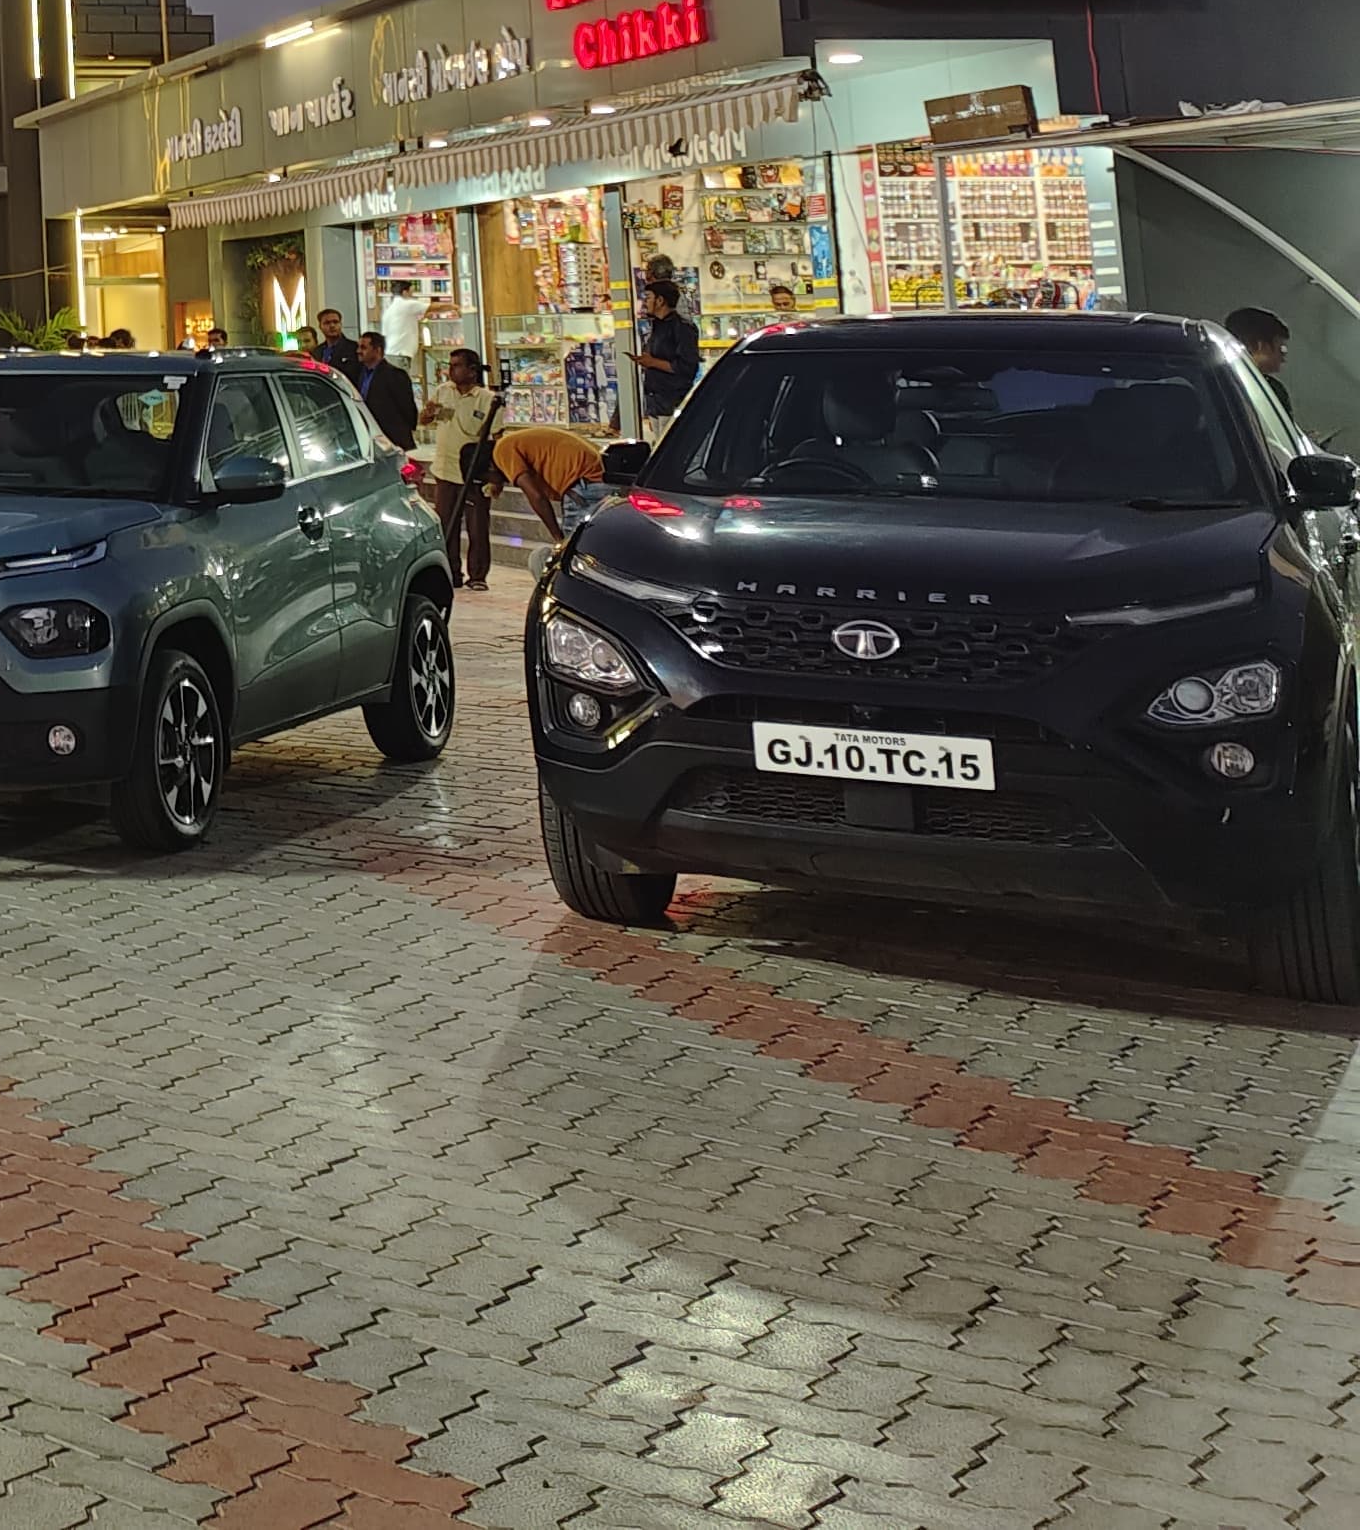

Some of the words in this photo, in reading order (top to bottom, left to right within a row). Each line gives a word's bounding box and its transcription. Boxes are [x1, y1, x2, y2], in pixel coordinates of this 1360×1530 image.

[736, 581, 992, 605] HARRIER
[834, 732, 860, 744] TATA
[862, 734, 907, 746] MOTORS
[767, 739, 981, 781] GJ.10.TC.15
